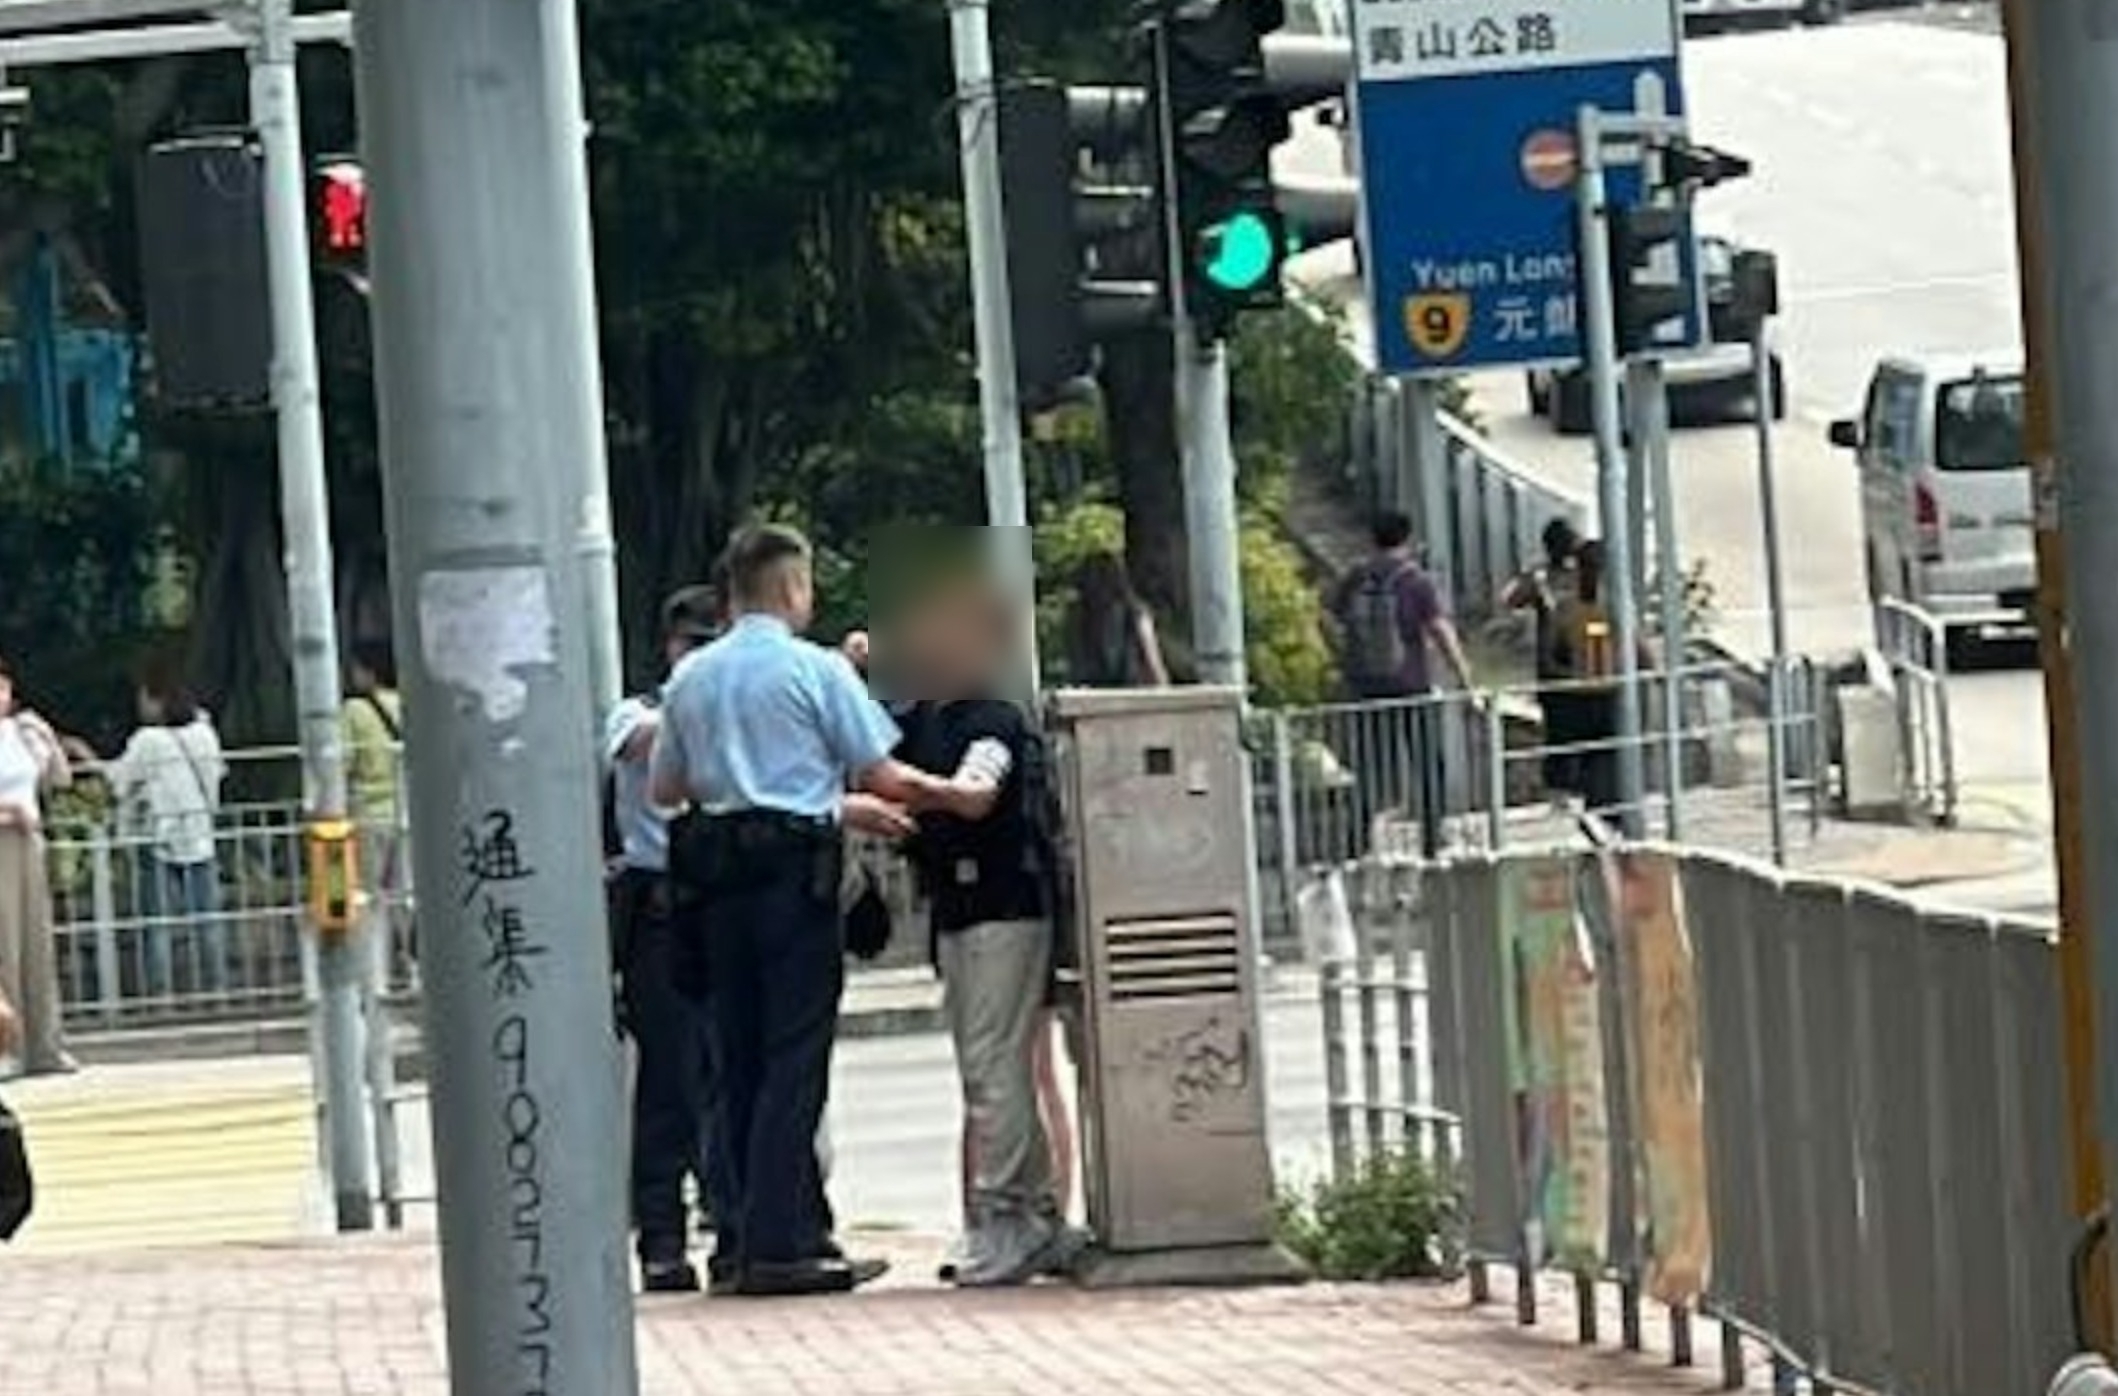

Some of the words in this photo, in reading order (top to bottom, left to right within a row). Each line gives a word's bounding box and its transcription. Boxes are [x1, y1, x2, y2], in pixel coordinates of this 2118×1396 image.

[1370, 13, 1555, 63] 青山公路
[1411, 258, 1498, 288] Yuen
[1424, 306, 1450, 344] 9
